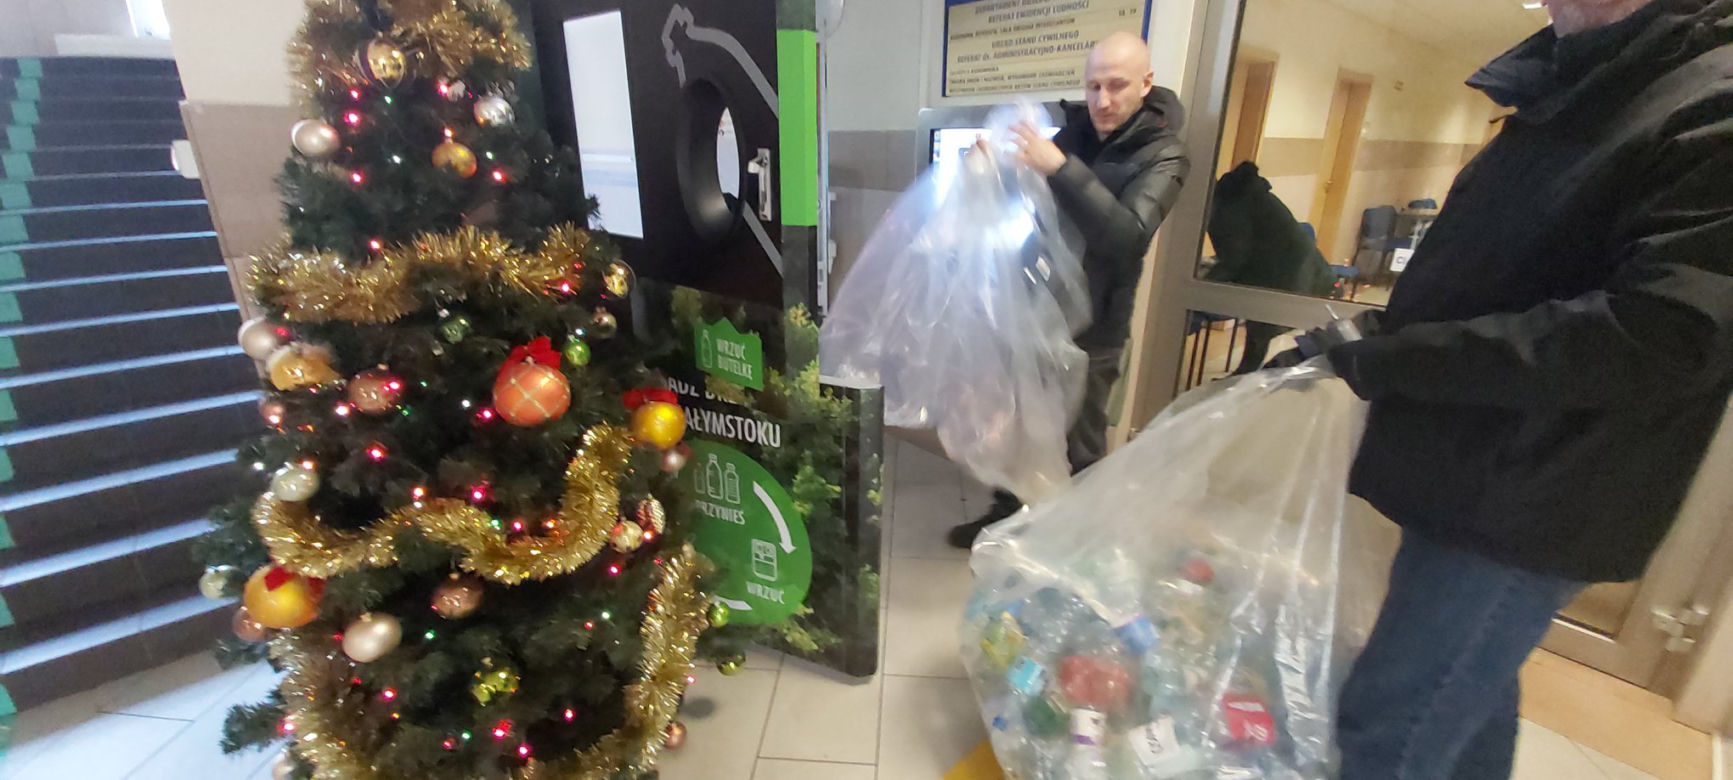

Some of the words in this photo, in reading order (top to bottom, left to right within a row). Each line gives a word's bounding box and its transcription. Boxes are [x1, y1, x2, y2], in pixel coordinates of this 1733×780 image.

[1015, 35, 1037, 46] STANU
[1038, 30, 1080, 43] CYWILNEGO
[684, 405, 782, 448] AŁYMSTOKU
